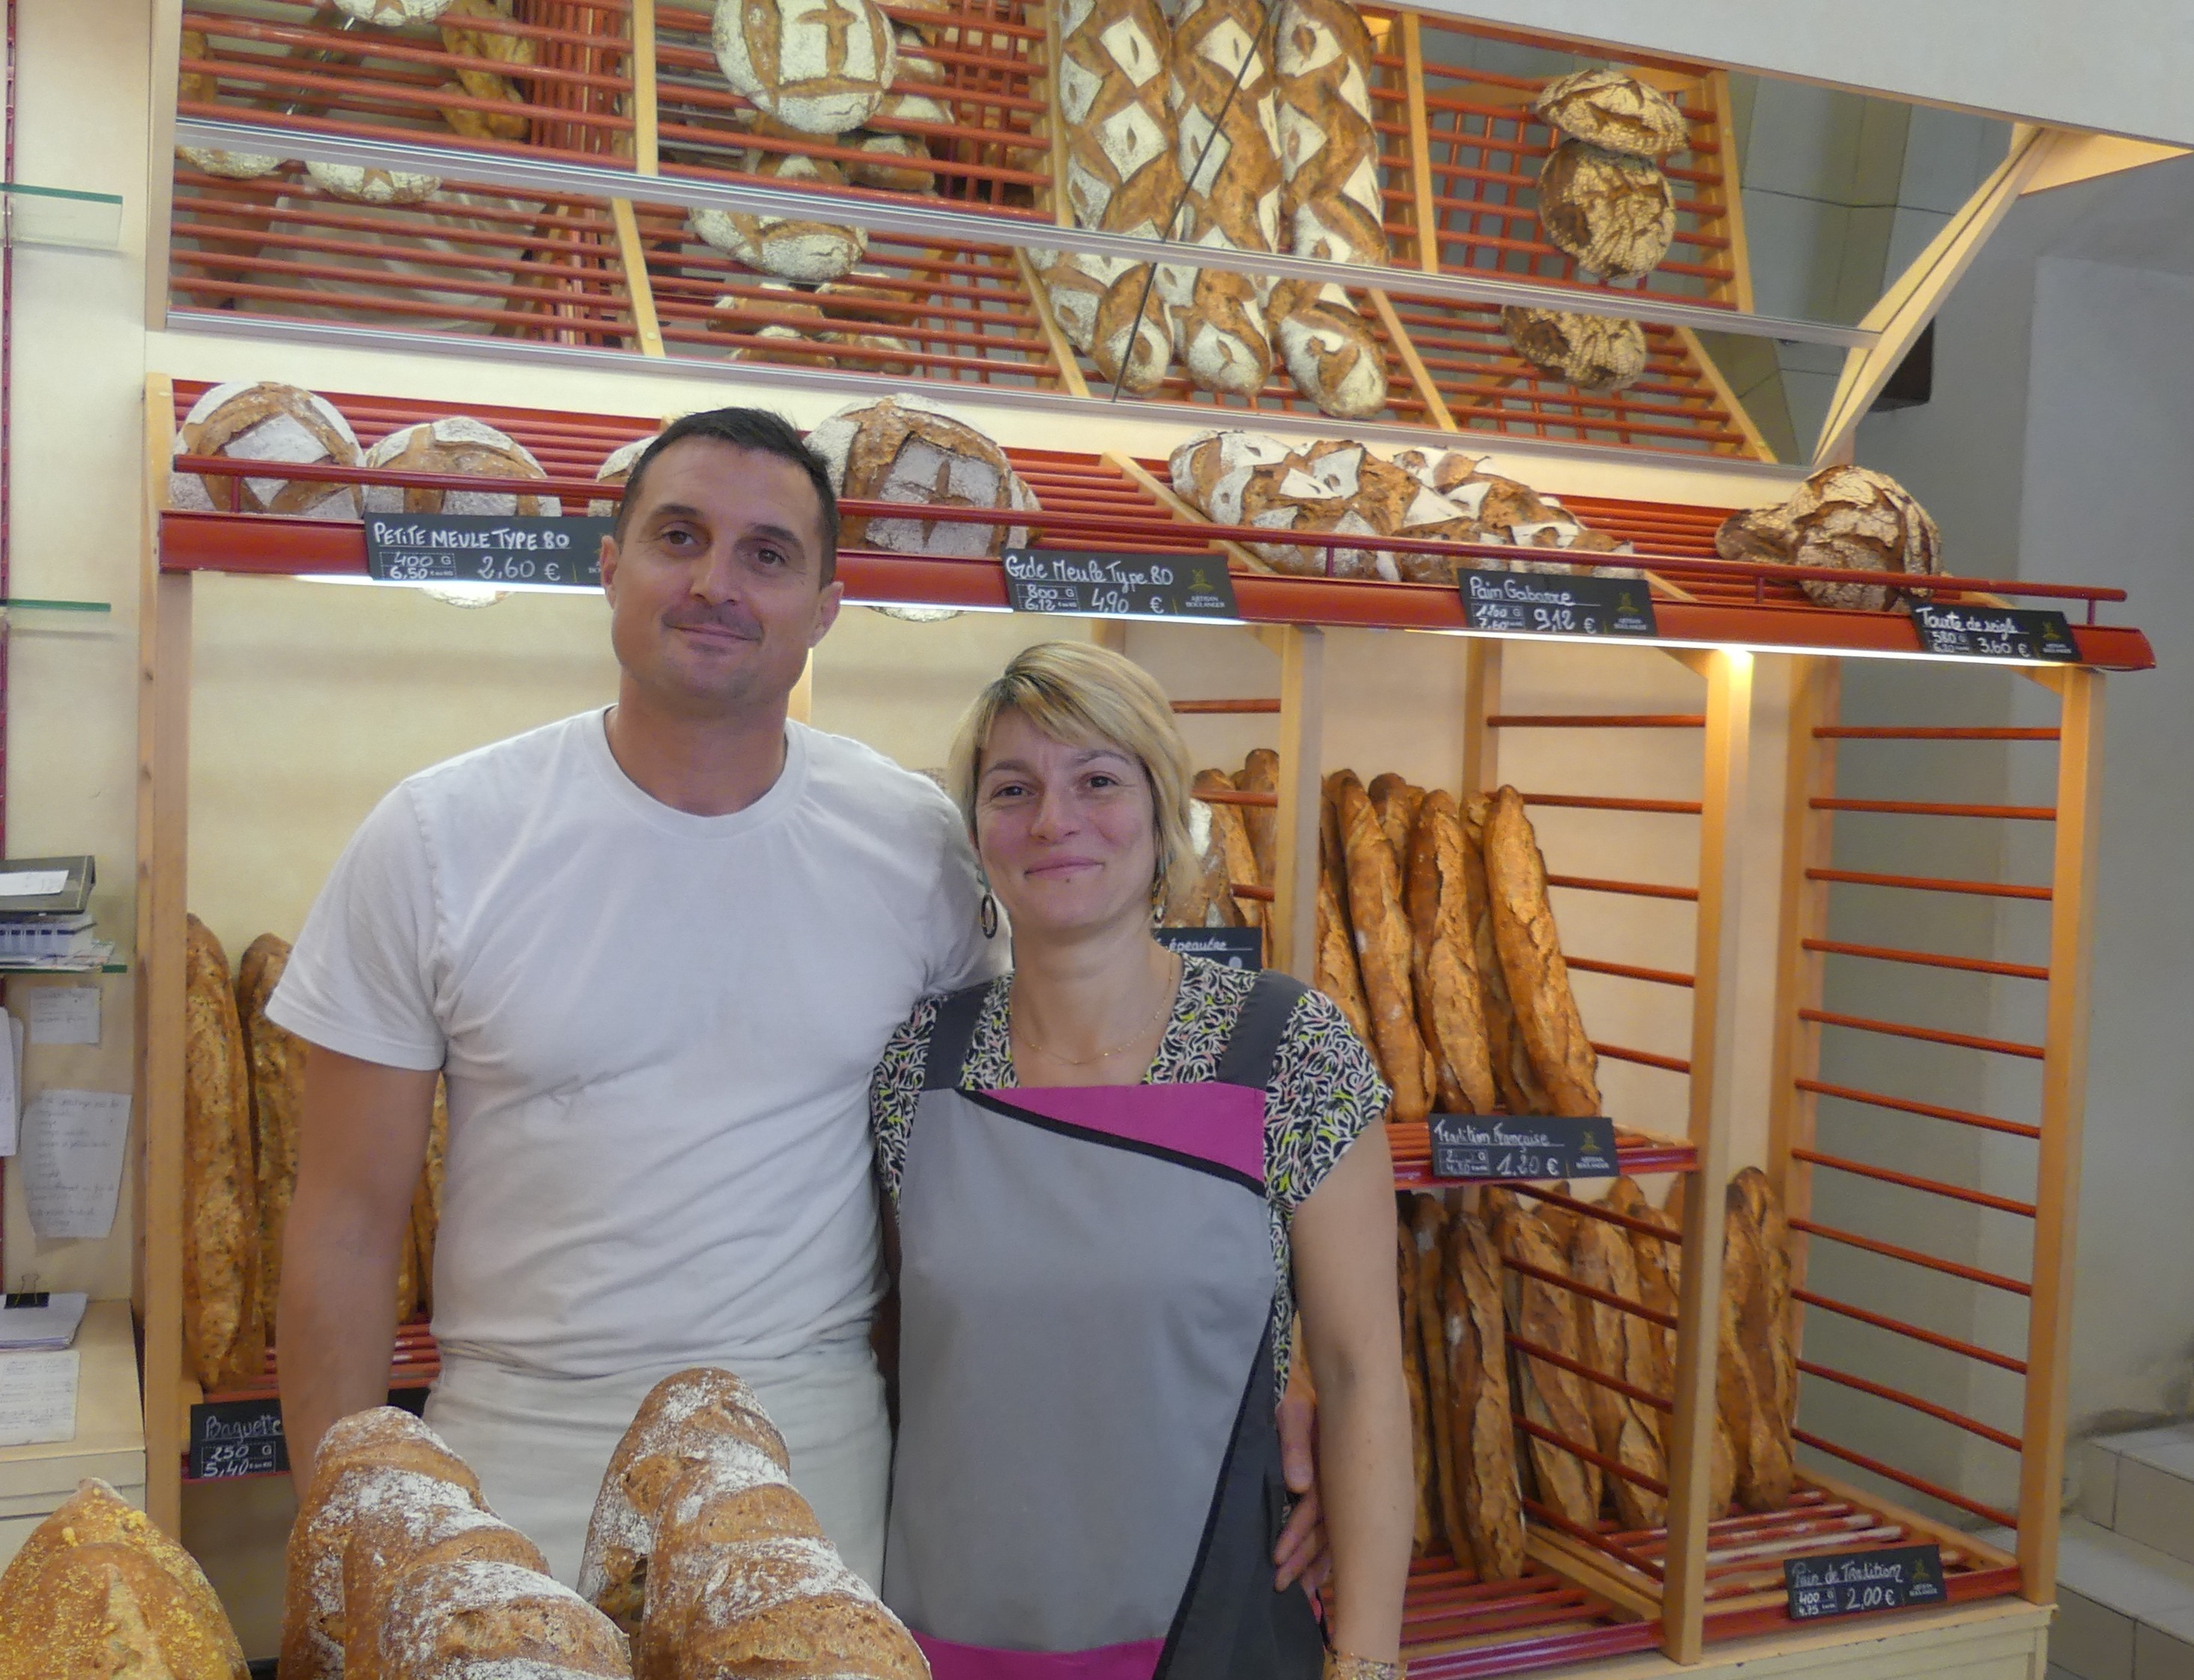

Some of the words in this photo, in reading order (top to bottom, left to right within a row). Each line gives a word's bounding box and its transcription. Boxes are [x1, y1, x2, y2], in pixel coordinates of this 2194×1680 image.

[373, 521, 426, 546] PETITE
[431, 530, 491, 549] MEULE
[491, 528, 538, 551] TYPE
[542, 530, 571, 549] 80
[393, 551, 434, 567] 400
[440, 555, 452, 565] G
[544, 562, 561, 581] €
[1052, 556, 1107, 583] Meule
[1106, 560, 1149, 593] Type
[1150, 565, 1174, 585] 80
[1027, 584, 1058, 599] 800
[1065, 588, 1075, 598] G
[1469, 575, 1503, 600] Pain
[1149, 596, 1165, 614] €
[1583, 617, 1597, 634] €
[2018, 643, 2030, 658] €
[1546, 1157, 1560, 1177] €
[210, 1445, 249, 1461] 250
[262, 1445, 272, 1455] G
